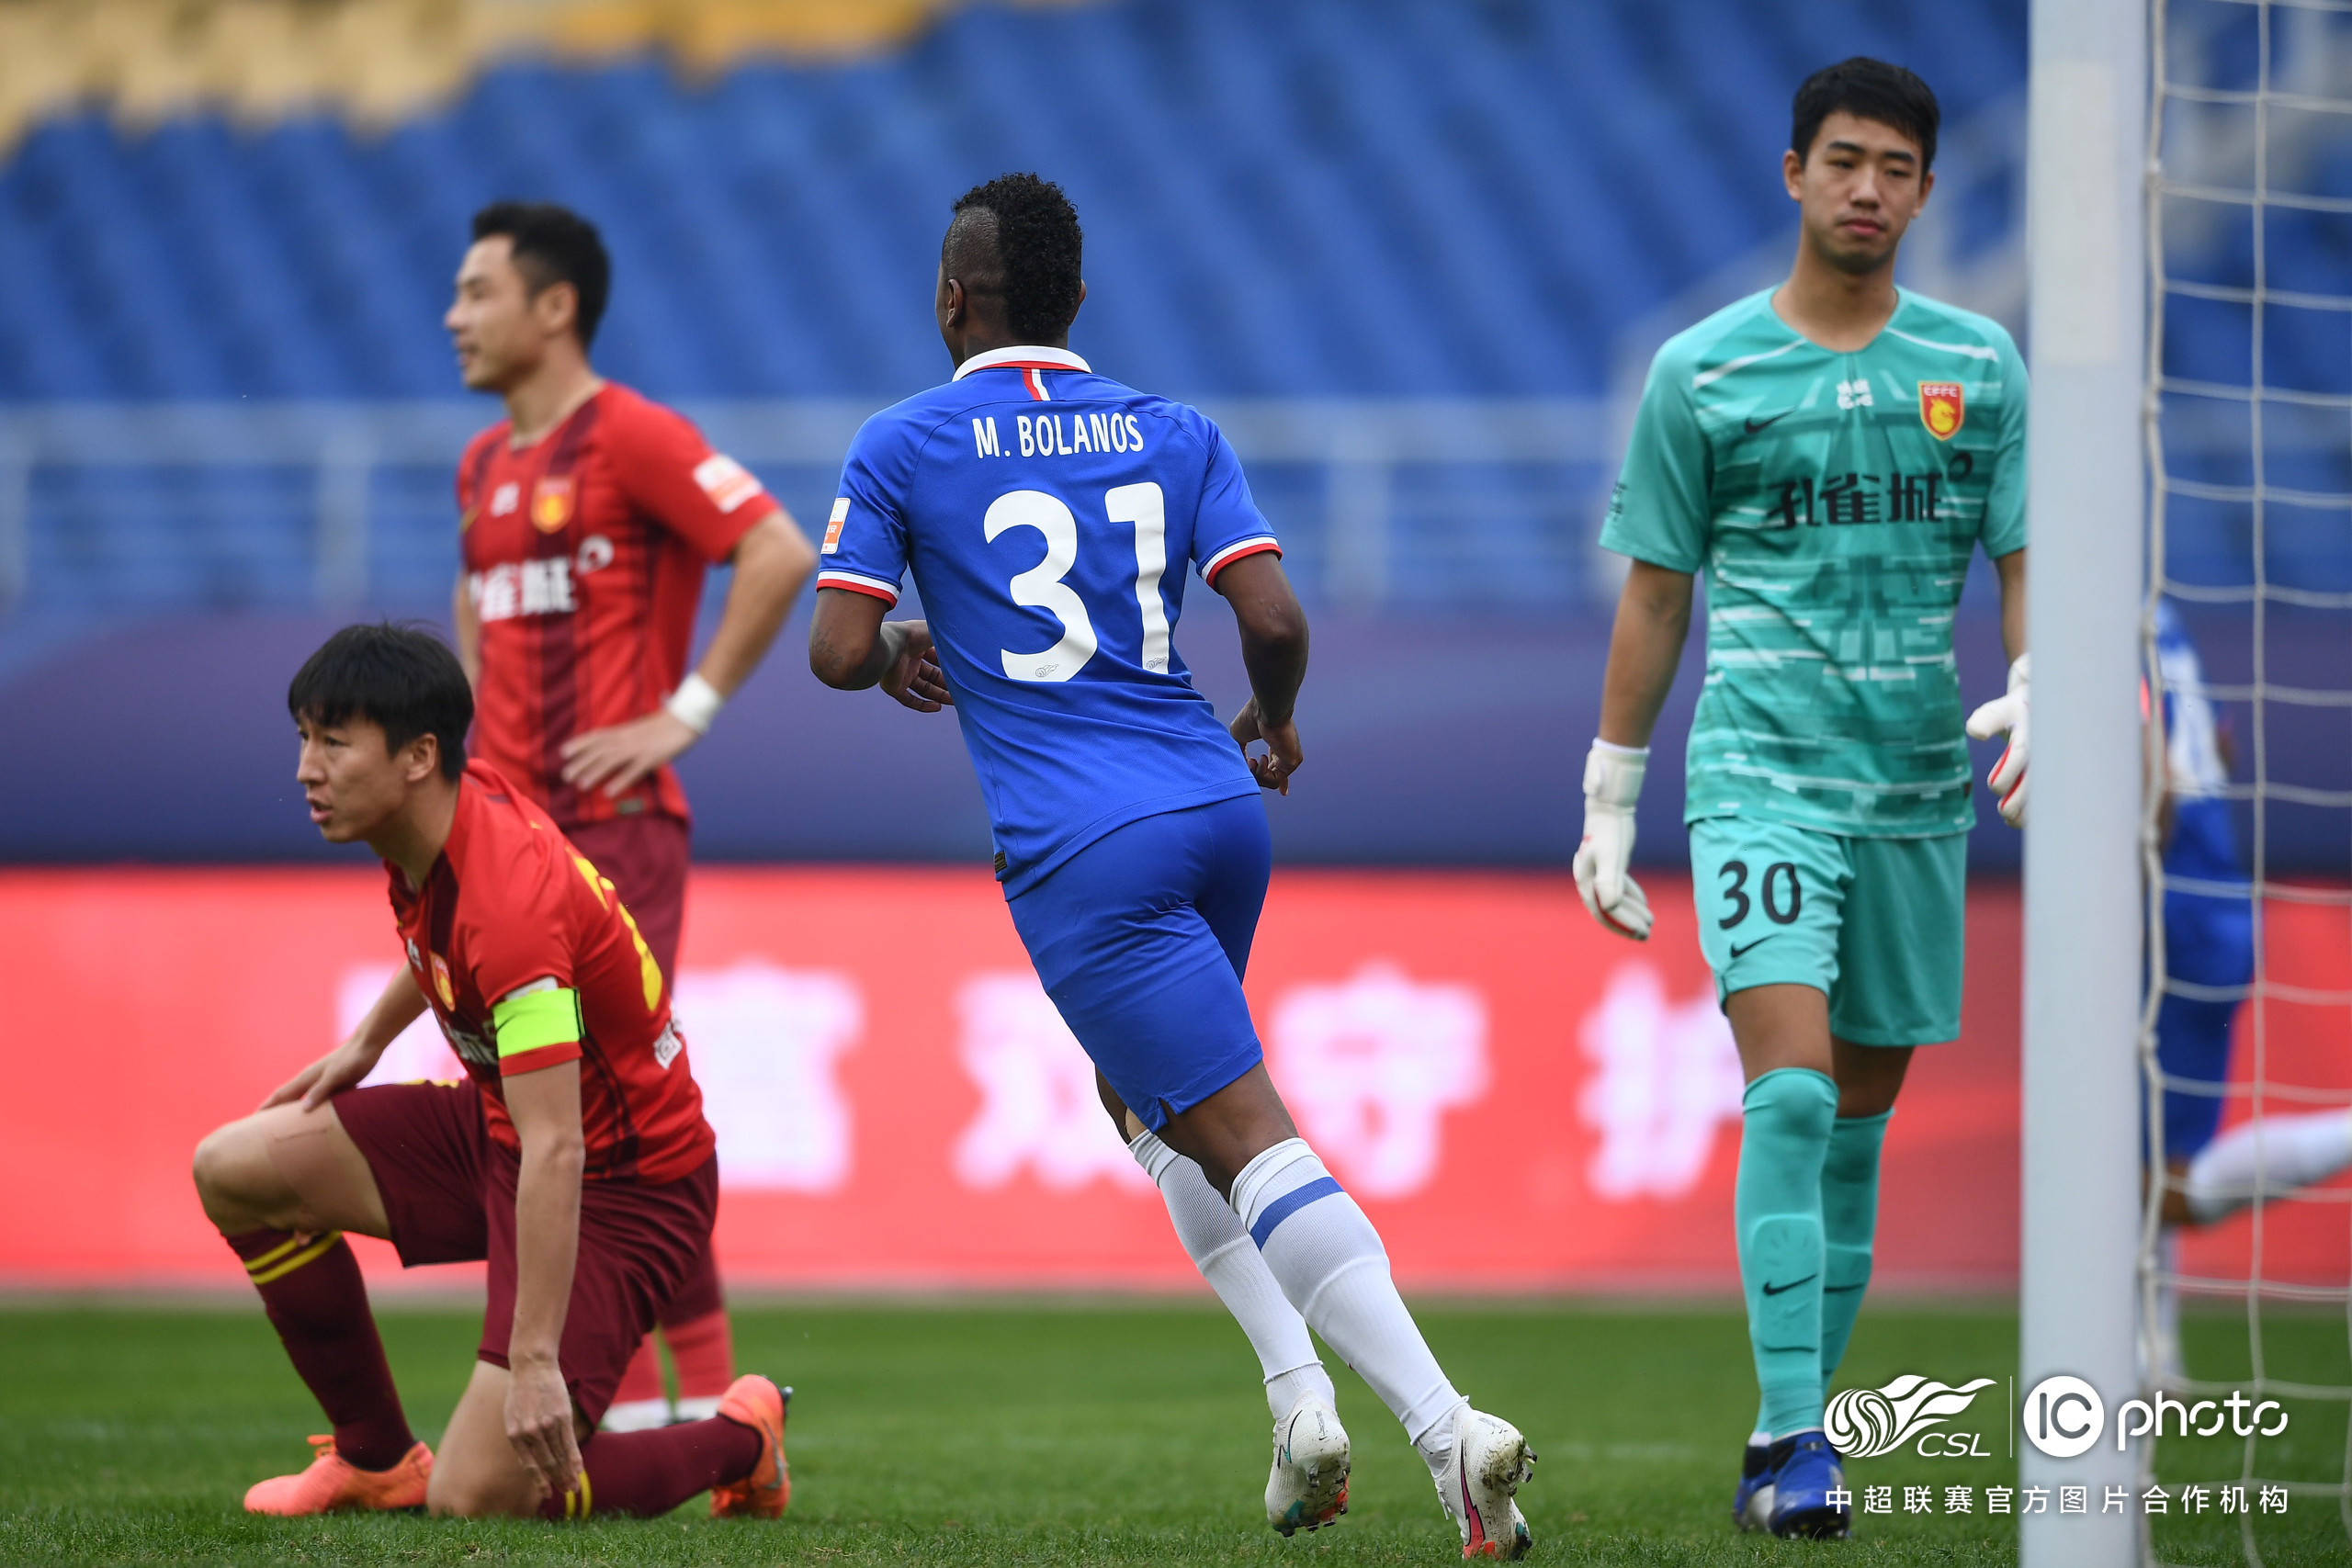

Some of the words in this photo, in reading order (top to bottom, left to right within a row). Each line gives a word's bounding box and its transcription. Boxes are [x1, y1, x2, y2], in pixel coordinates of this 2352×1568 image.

[972, 416, 1011, 459] M.
[1017, 412, 1144, 457] BOLANOS
[1765, 471, 1944, 530] 孔雀城
[983, 481, 1170, 682] 31
[1718, 860, 1802, 931] 30
